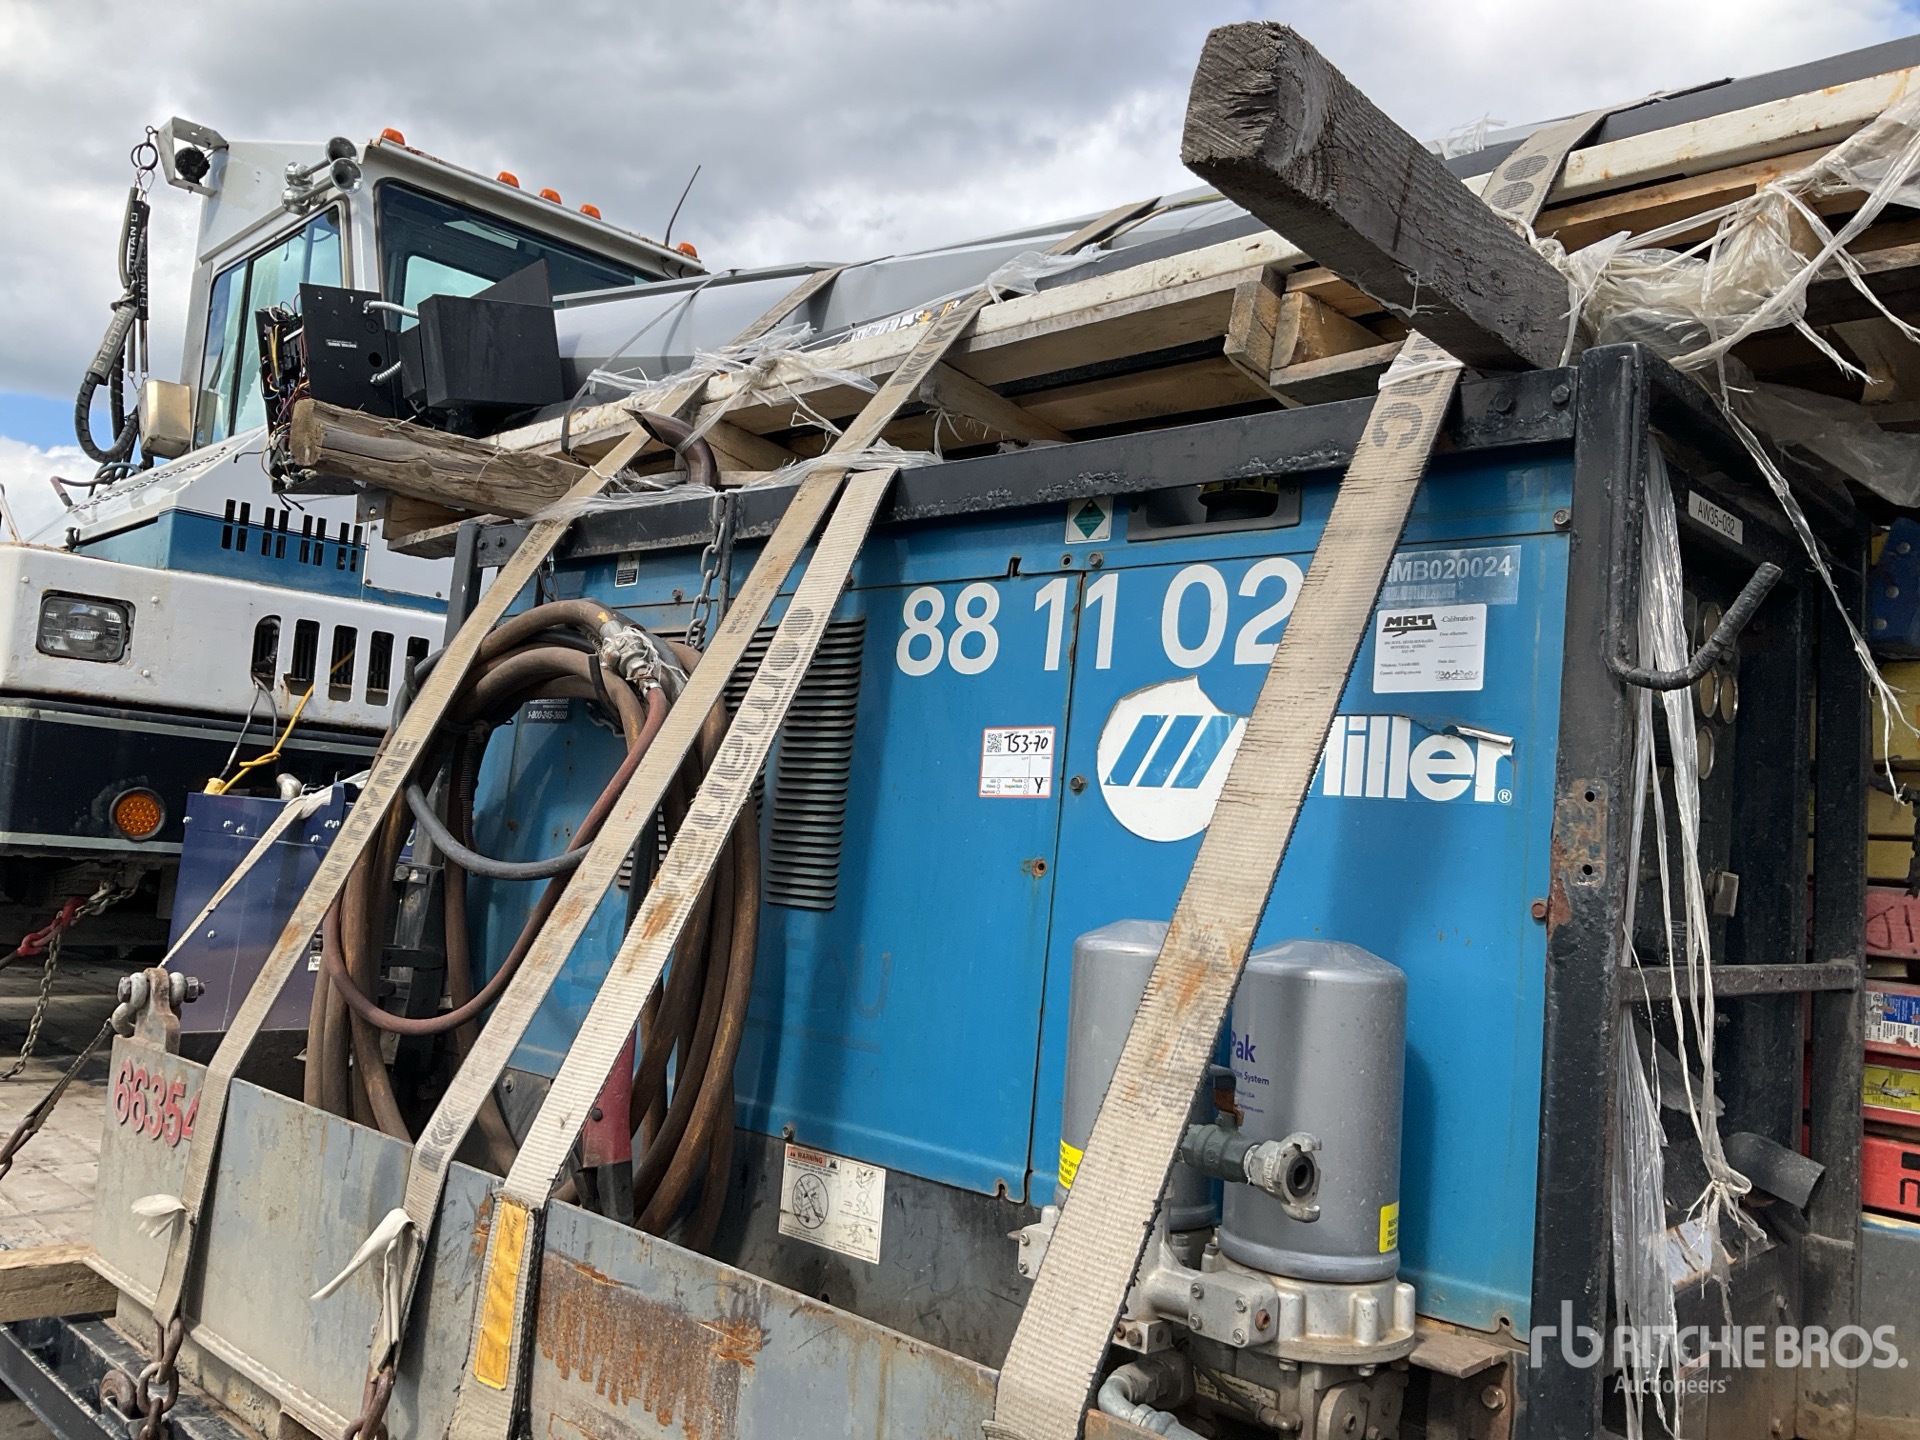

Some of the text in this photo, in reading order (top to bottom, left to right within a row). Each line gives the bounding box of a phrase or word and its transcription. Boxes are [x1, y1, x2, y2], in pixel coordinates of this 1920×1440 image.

[896, 557, 1305, 676] 88 11 02
[1384, 613, 1433, 628] MRT
[1244, 1071, 1270, 1086] System
[797, 1151, 823, 1164] WARNING
